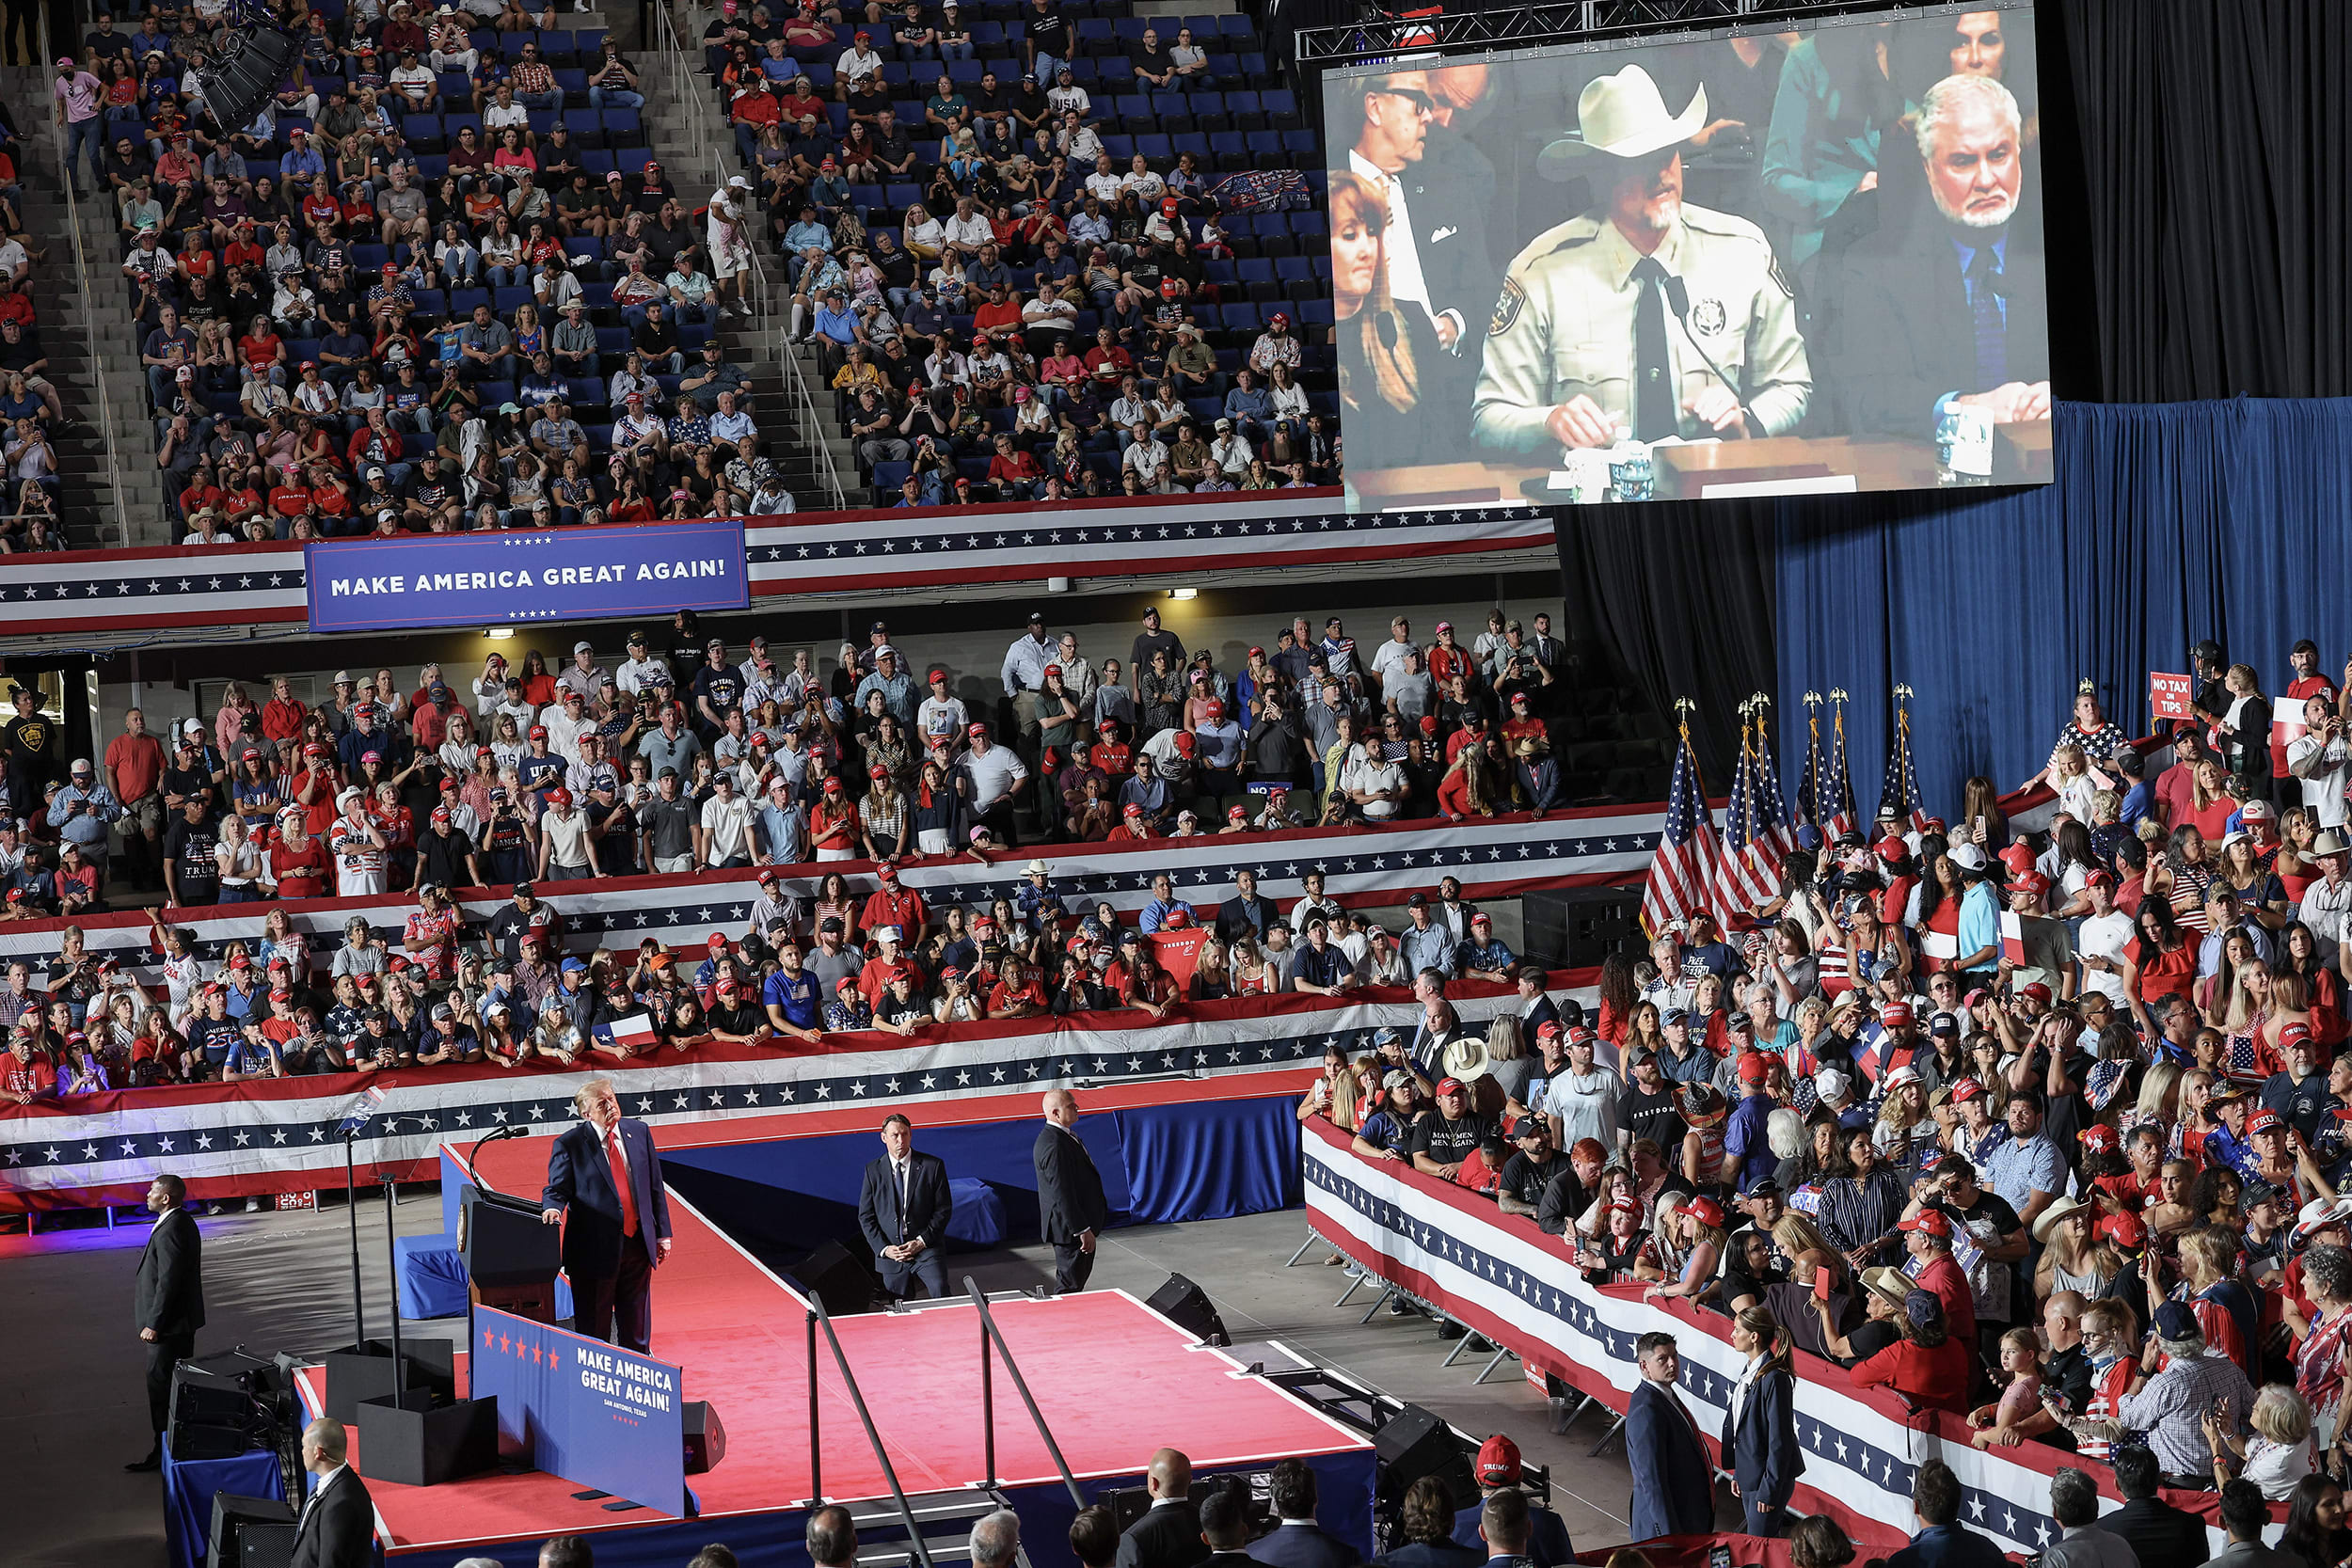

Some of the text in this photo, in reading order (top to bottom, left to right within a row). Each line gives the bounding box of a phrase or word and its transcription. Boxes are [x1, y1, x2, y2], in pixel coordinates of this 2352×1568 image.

[1056, 99, 1077, 110] USA
[331, 559, 725, 596] MAKE AMERICA GREAT AGAIN!
[2153, 678, 2188, 693] NO TAX
[2160, 700, 2183, 714] TIPS
[530, 764, 558, 778] UA
[492, 837, 521, 848] VANCE
[184, 865, 215, 875] TRUM
[1163, 940, 1195, 949] FREEDOM
[1686, 956, 1706, 966] FREE
[163, 963, 179, 980] USA
[1024, 971, 1041, 981] TAX
[206, 1025, 237, 1036] AMERICA
[2284, 1026, 2308, 1037] TRUMP
[1633, 1106, 1676, 1120] FREEDOM
[2252, 1114, 2277, 1129] TRU
[1452, 1138, 1475, 1148] AGAIN
[1789, 1194, 1820, 1213] TEXA
[578, 1347, 673, 1392] MAKE AMERICA
[580, 1370, 670, 1413] GREAT AGAIN!
[603, 1399, 647, 1418] SAN ANTONIO, TEXAS
